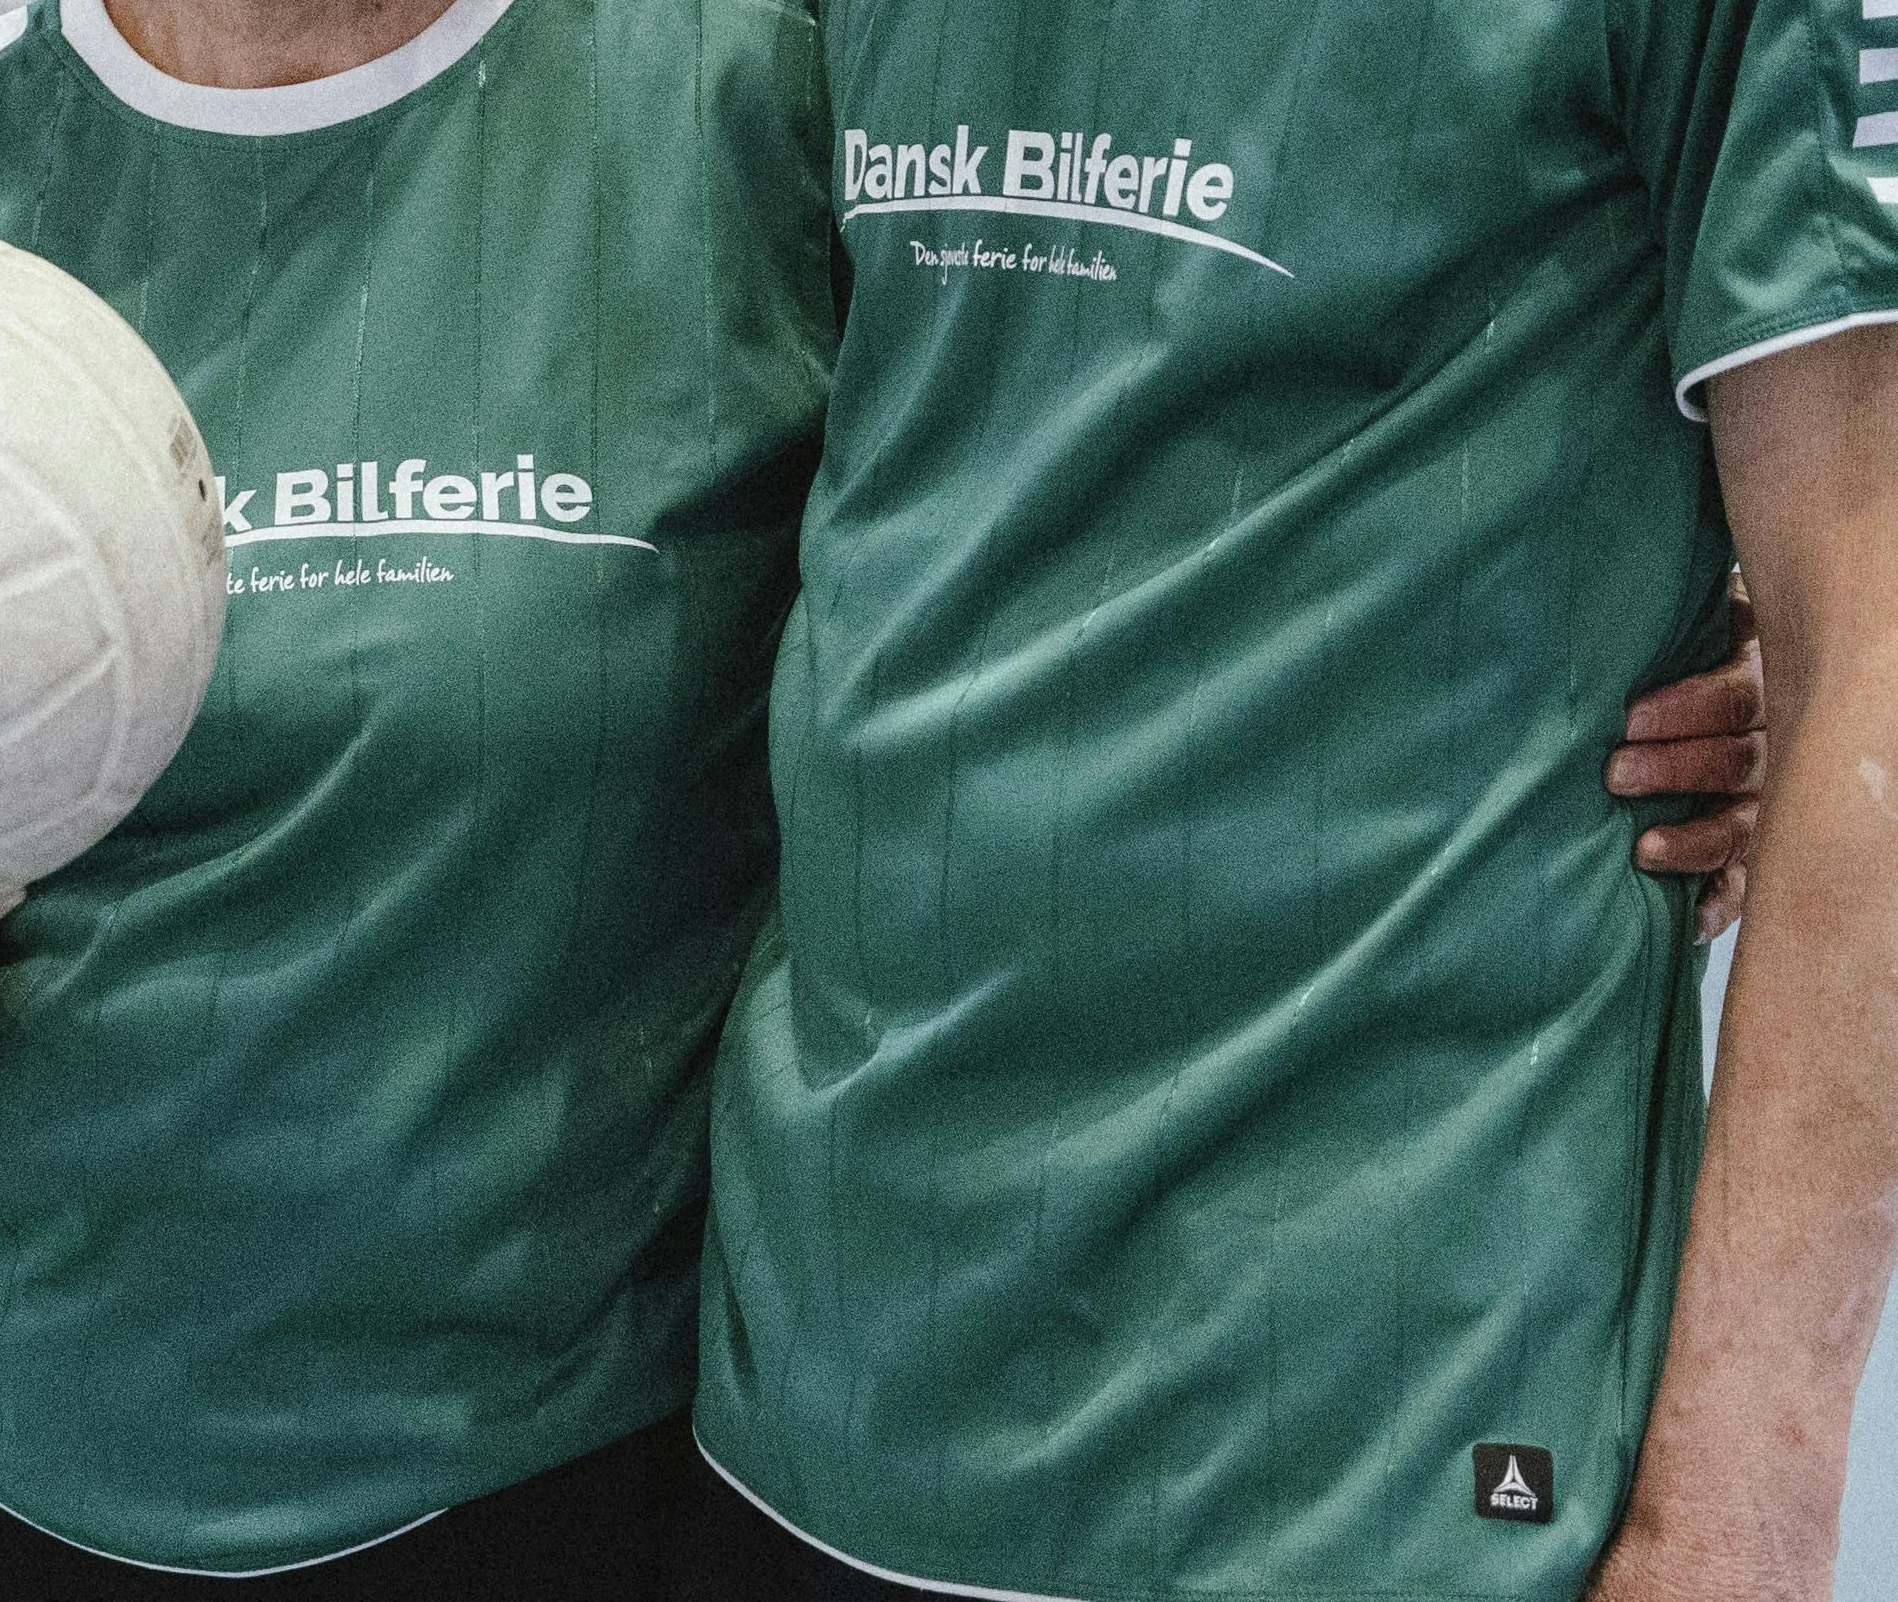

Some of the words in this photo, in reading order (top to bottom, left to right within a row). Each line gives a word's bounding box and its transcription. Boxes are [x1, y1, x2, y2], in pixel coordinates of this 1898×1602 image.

[844, 125, 989, 201] Dansk
[1003, 129, 1234, 221] Bilferie
[973, 239, 1017, 270] ferie
[1021, 242, 1048, 273] for
[274, 454, 594, 526] Bilferie
[250, 566, 295, 593] ferie
[300, 563, 329, 590] for
[334, 558, 372, 586] hele
[377, 556, 454, 583] familien
[1490, 1493, 1539, 1511] SELECT
